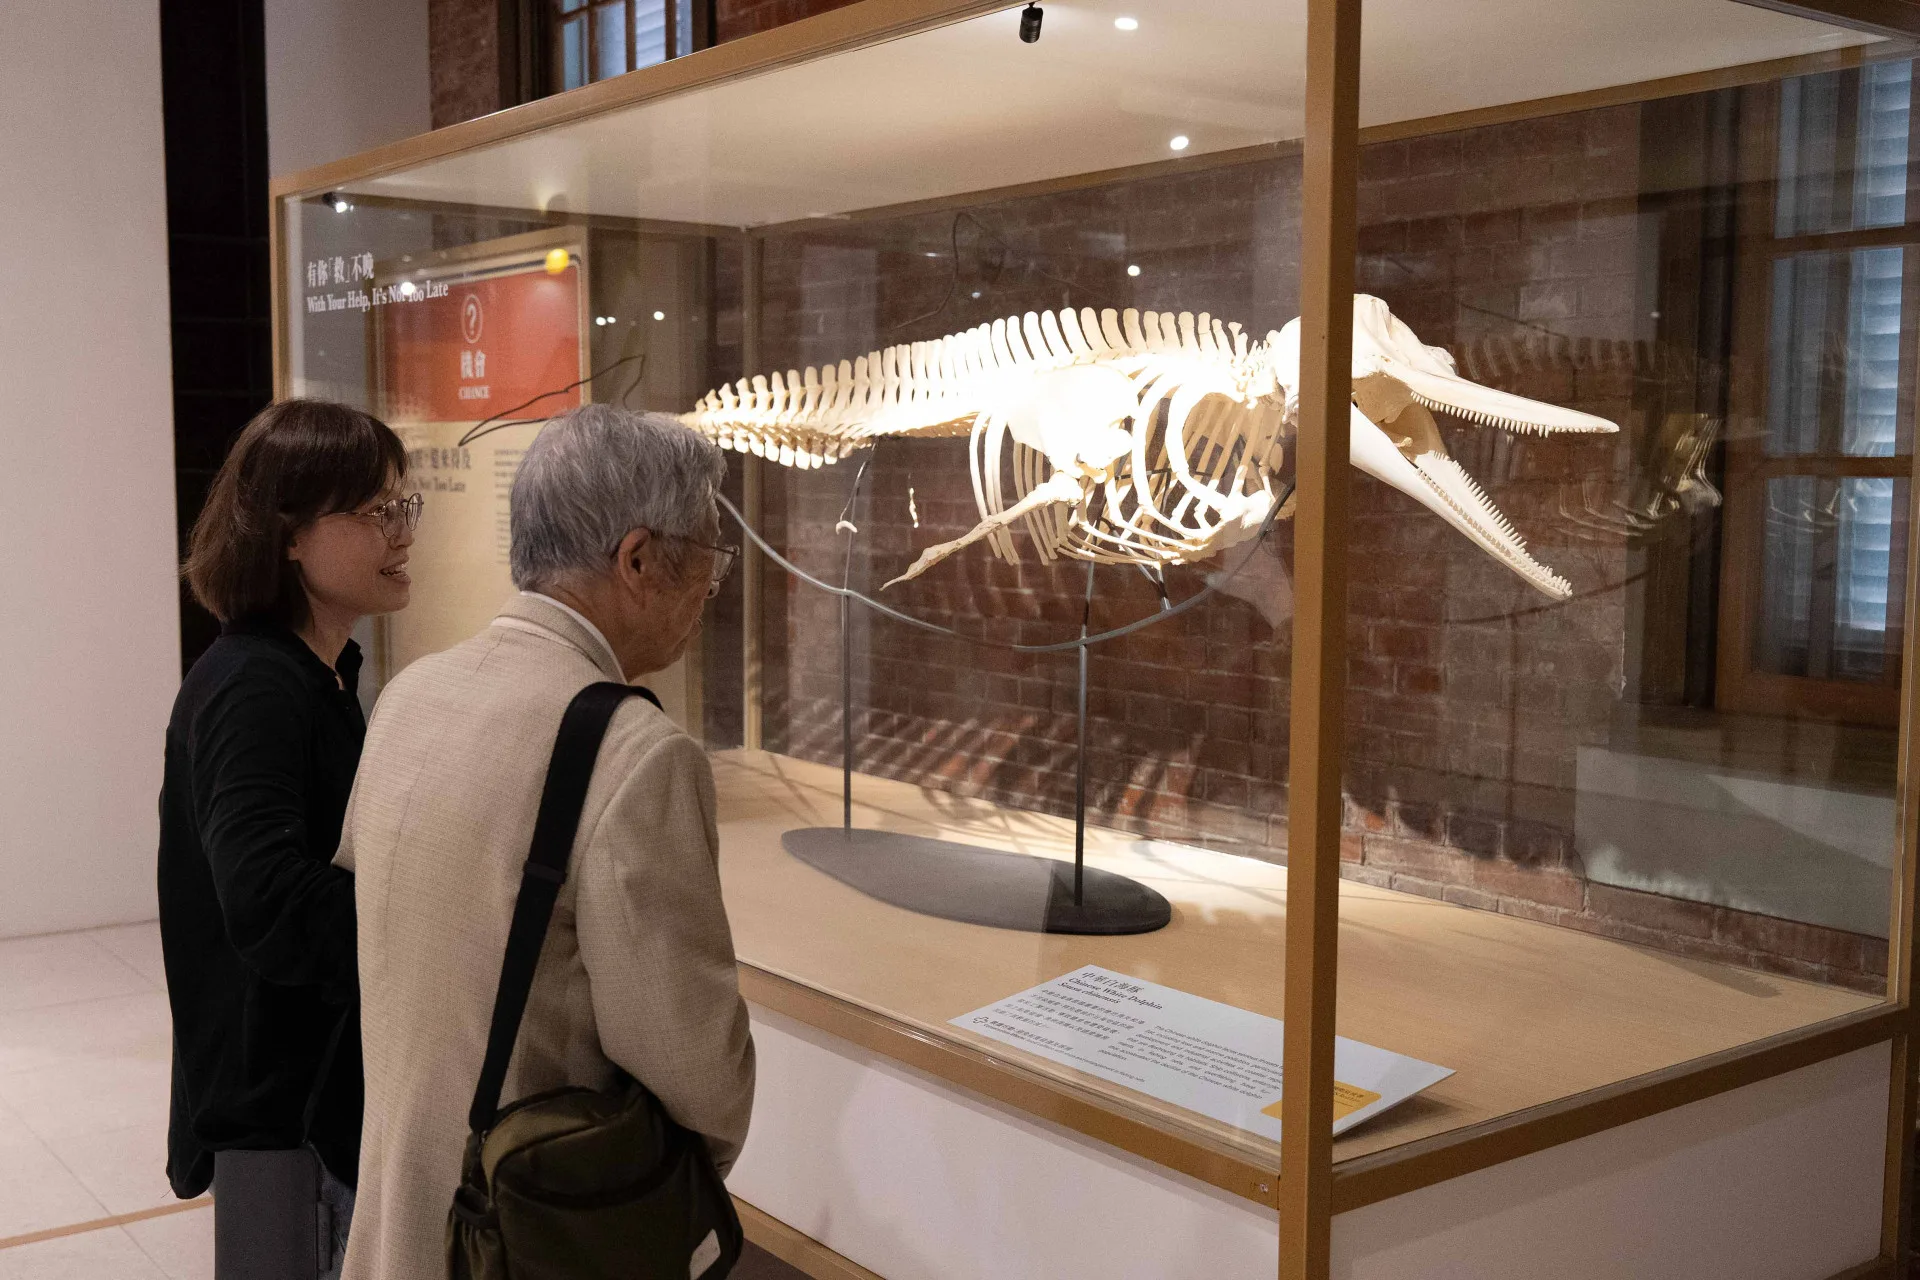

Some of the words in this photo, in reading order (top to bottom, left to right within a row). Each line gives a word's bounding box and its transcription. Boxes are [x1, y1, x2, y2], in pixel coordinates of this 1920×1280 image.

[306, 295, 327, 313] With
[326, 293, 346, 311] Your
[347, 289, 371, 313] Help,
[372, 287, 388, 306] It's
[426, 280, 449, 299] Late
[459, 385, 490, 400] CHANCE
[1068, 977, 1101, 990] Chinese
[1103, 987, 1128, 999] White
[1127, 995, 1163, 1010] Dolphin
